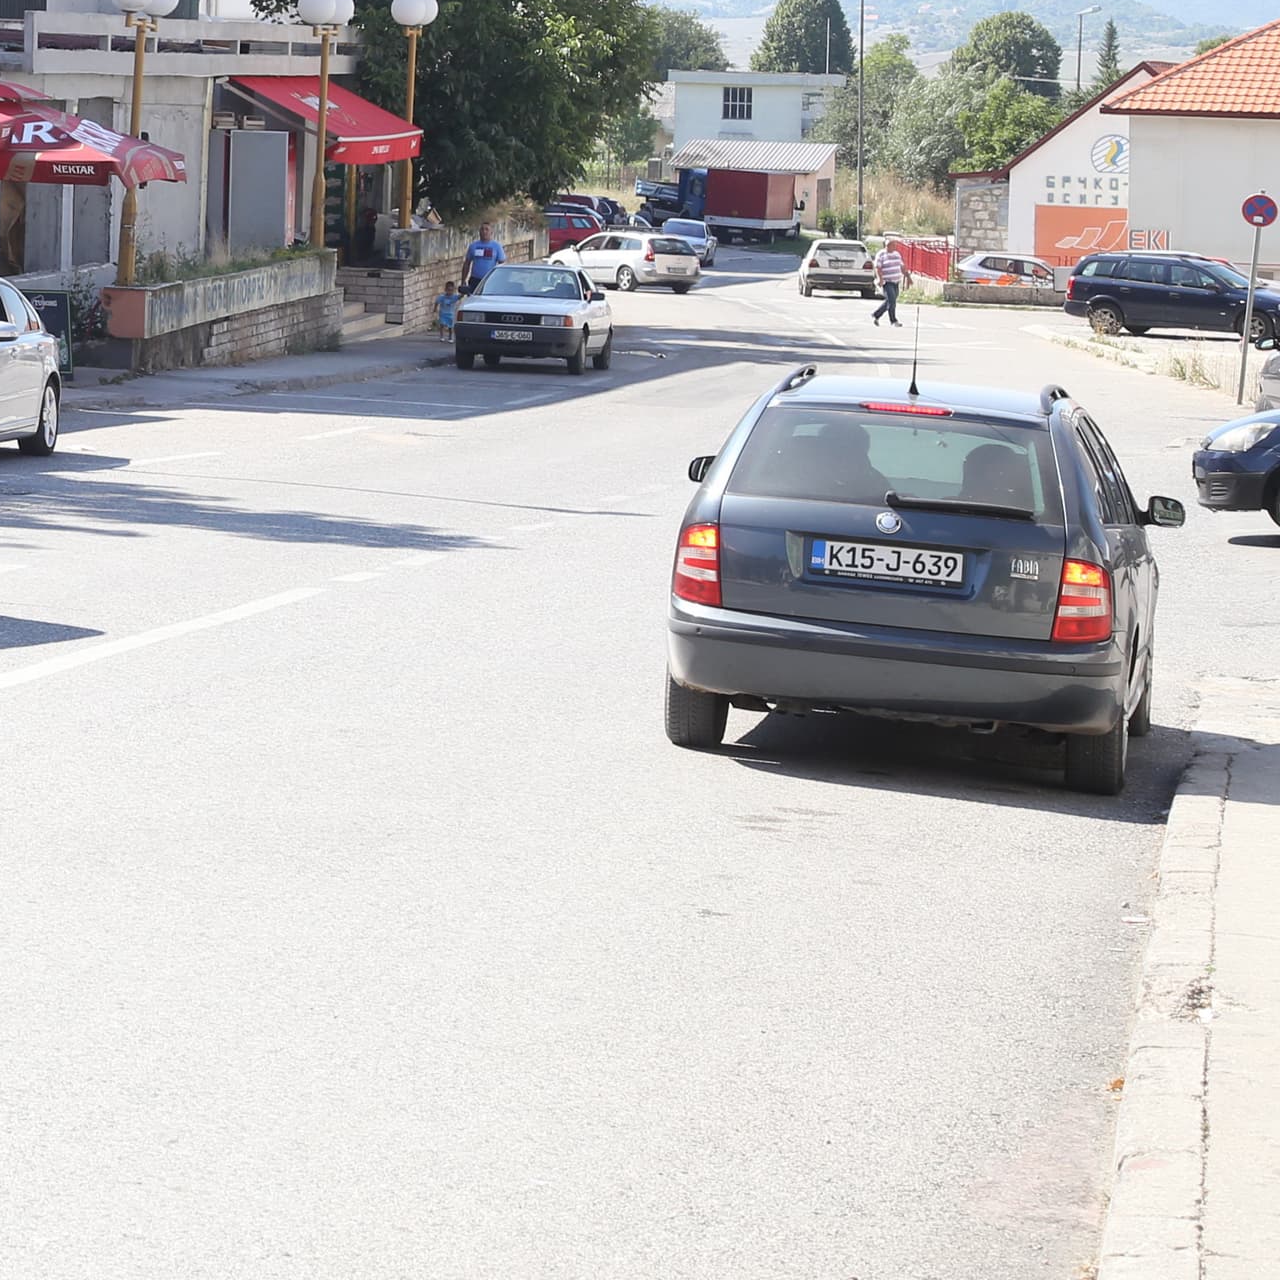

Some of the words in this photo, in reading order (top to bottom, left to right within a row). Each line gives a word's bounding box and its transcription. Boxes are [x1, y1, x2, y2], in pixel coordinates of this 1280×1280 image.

[53, 164, 95, 175] NEKTAR
[1129, 230, 1171, 250] EKI
[828, 545, 959, 577] K15-J-639
[1011, 558, 1038, 575] FABIA
